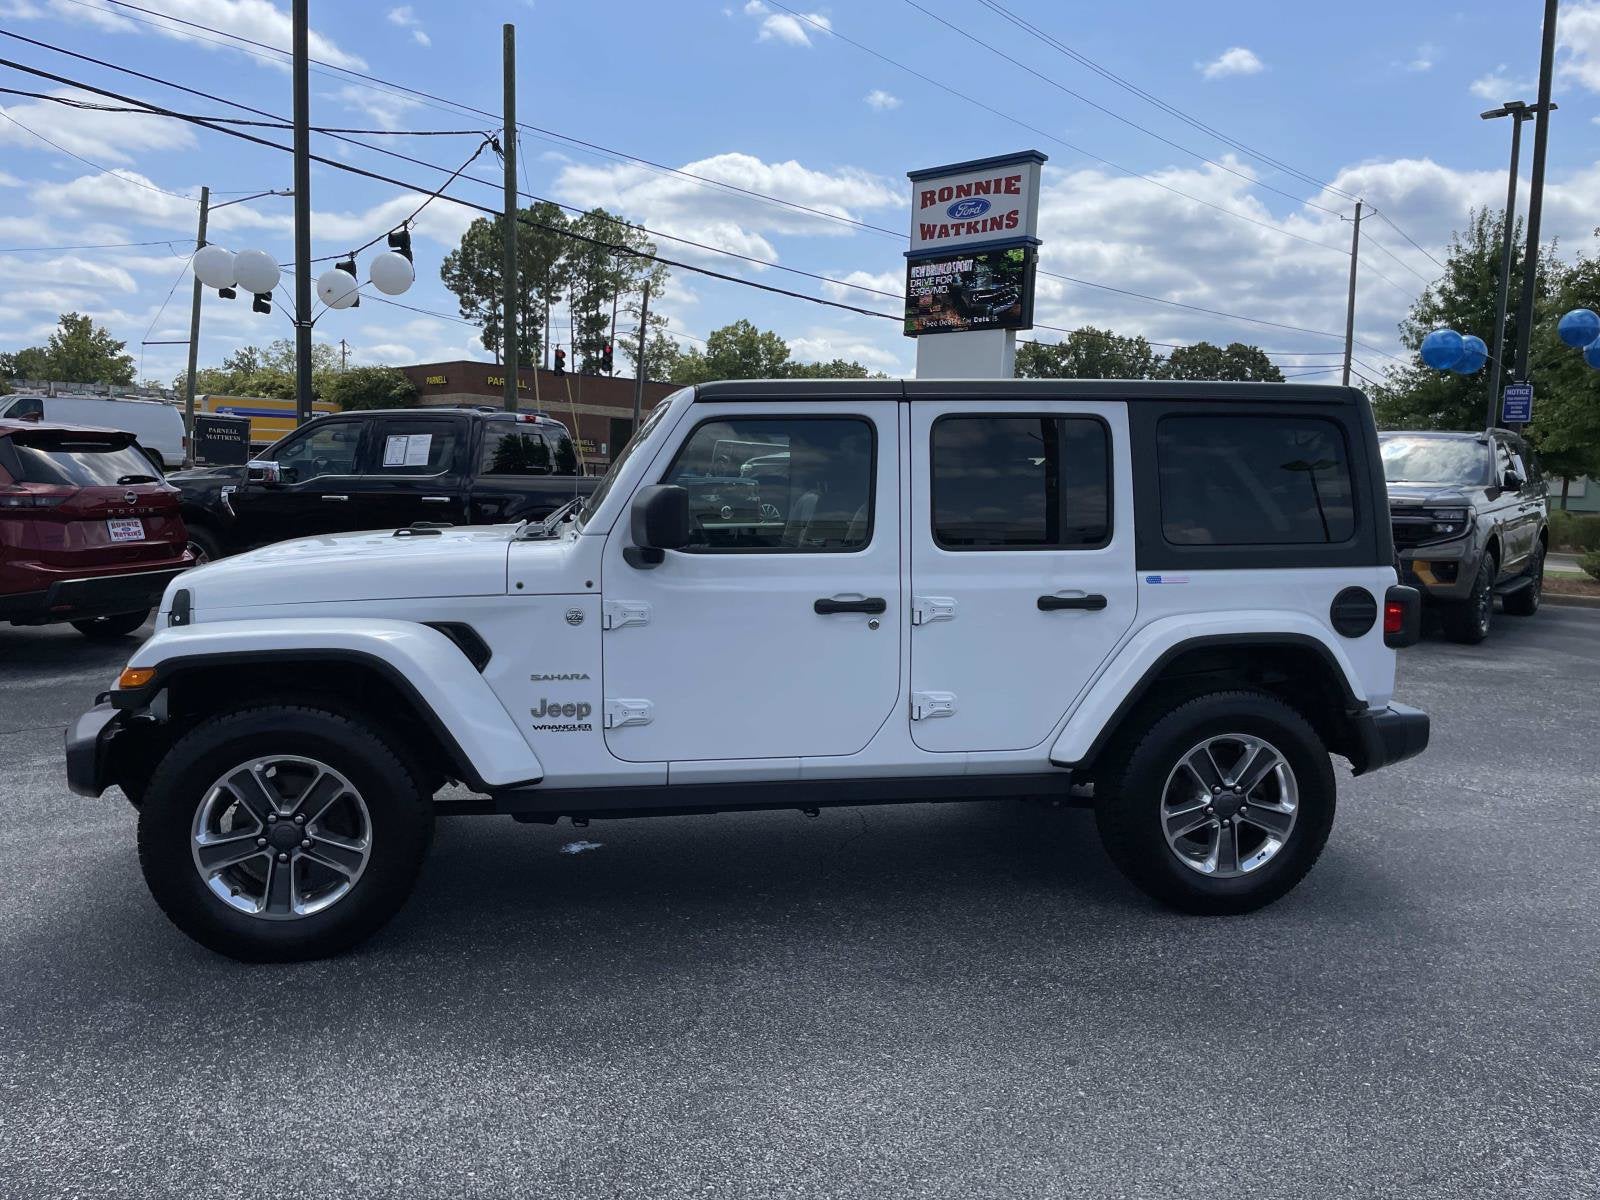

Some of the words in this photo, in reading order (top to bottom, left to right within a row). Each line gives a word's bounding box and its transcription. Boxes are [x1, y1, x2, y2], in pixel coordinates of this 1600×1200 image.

[920, 174, 1022, 209] RONNIE
[955, 201, 982, 217] Ford
[919, 209, 1019, 241] WATKINS
[911, 265, 925, 278] NEW
[910, 277, 935, 288] DRIVE
[935, 274, 953, 285] FOR
[426, 375, 447, 385] PARNELL
[487, 376, 527, 388] PARLL
[208, 427, 239, 435] PARNELL
[111, 521, 140, 529] RONNIE
[112, 530, 142, 538] WATKINS
[530, 673, 590, 681] SAHARA
[530, 698, 592, 721] Jeep
